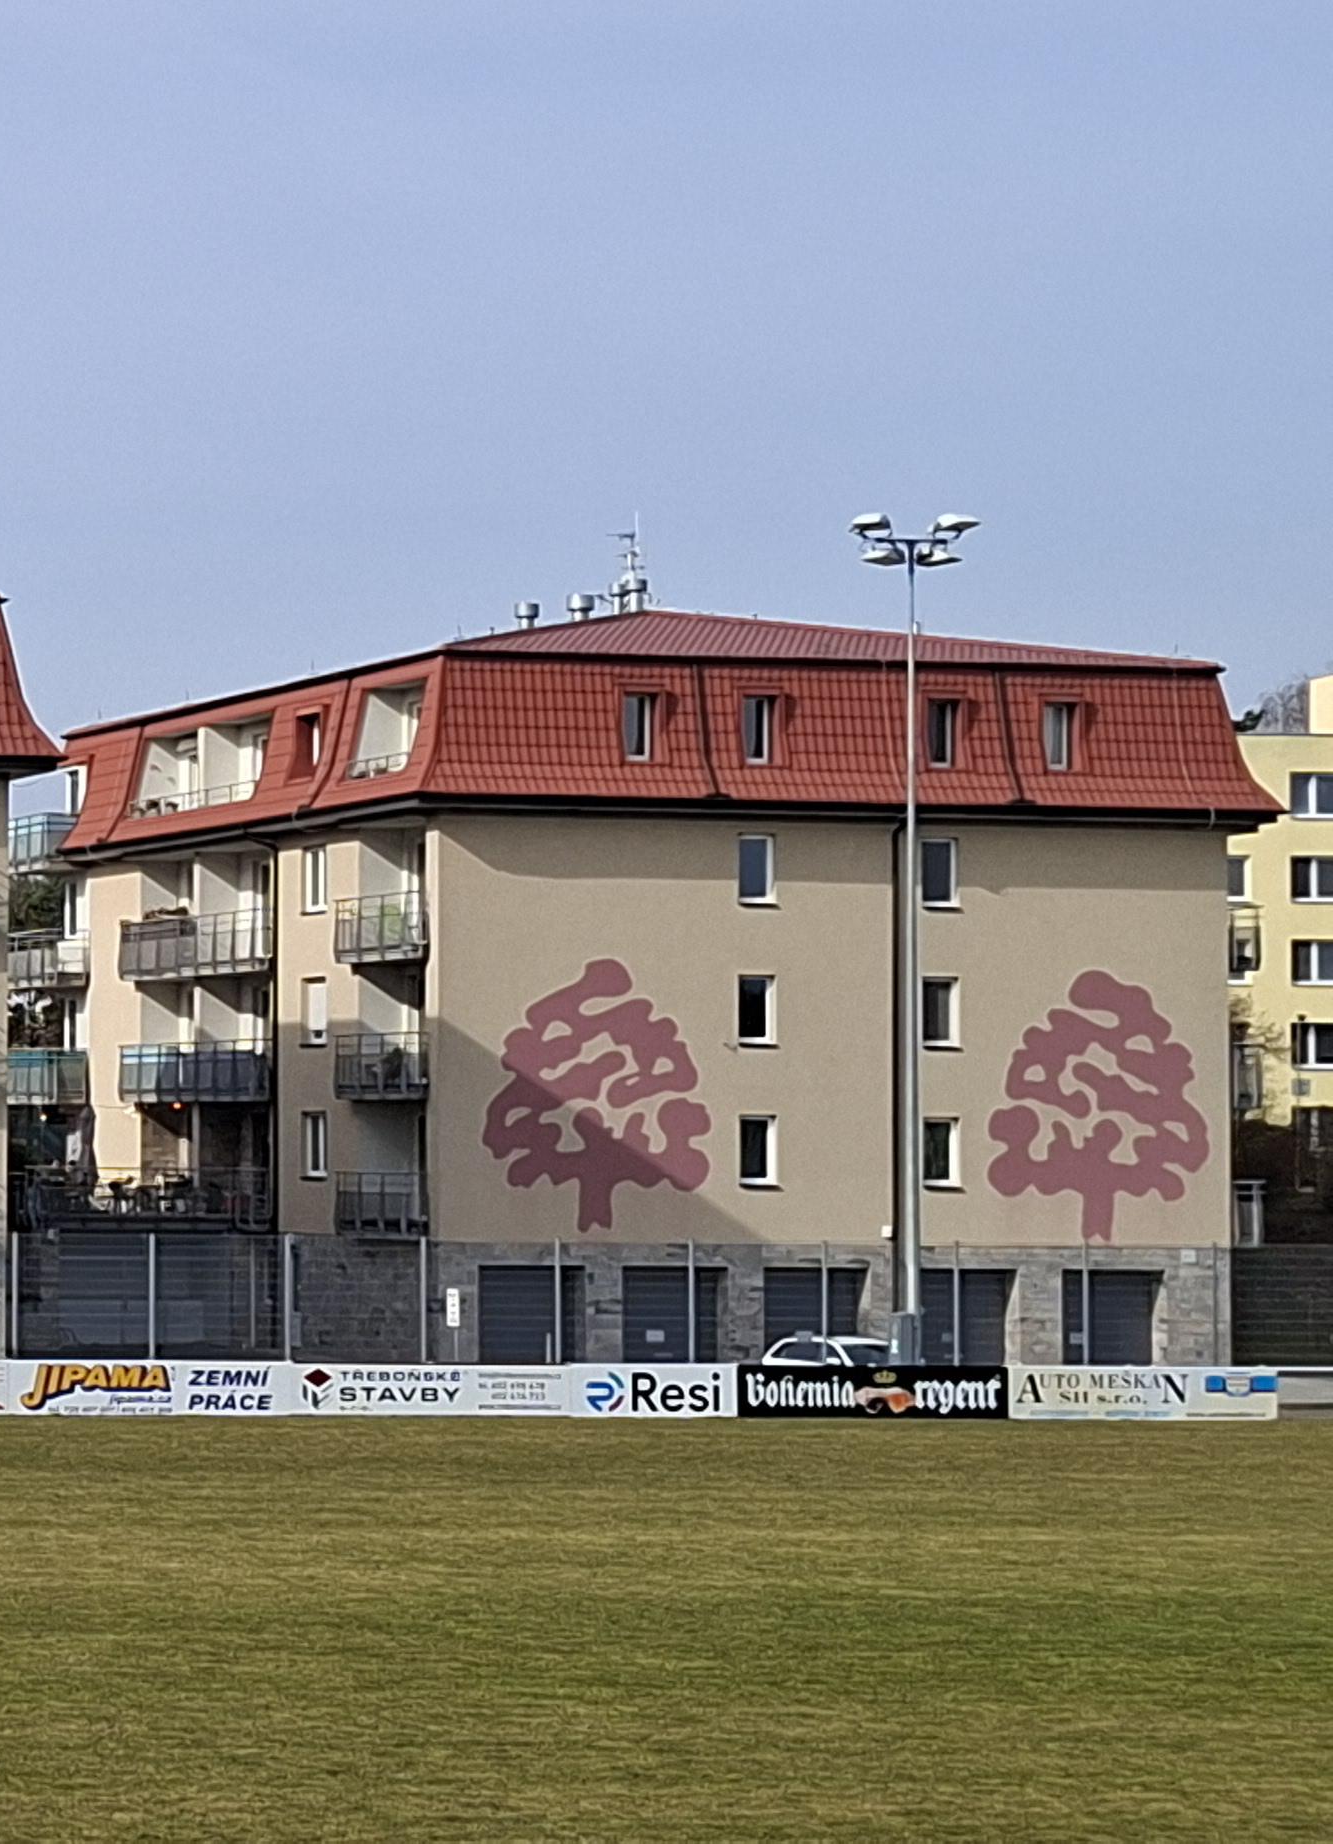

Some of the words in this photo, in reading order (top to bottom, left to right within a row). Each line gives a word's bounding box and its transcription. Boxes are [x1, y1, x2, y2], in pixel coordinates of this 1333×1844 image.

[20, 1364, 172, 1410] JIPAMA
[188, 1366, 270, 1387] ZEMNÍ
[746, 1371, 856, 1407] Bohemia
[188, 1391, 272, 1410] PRÁCE
[339, 1387, 460, 1402] STAVBY
[633, 1372, 721, 1412] Resi
